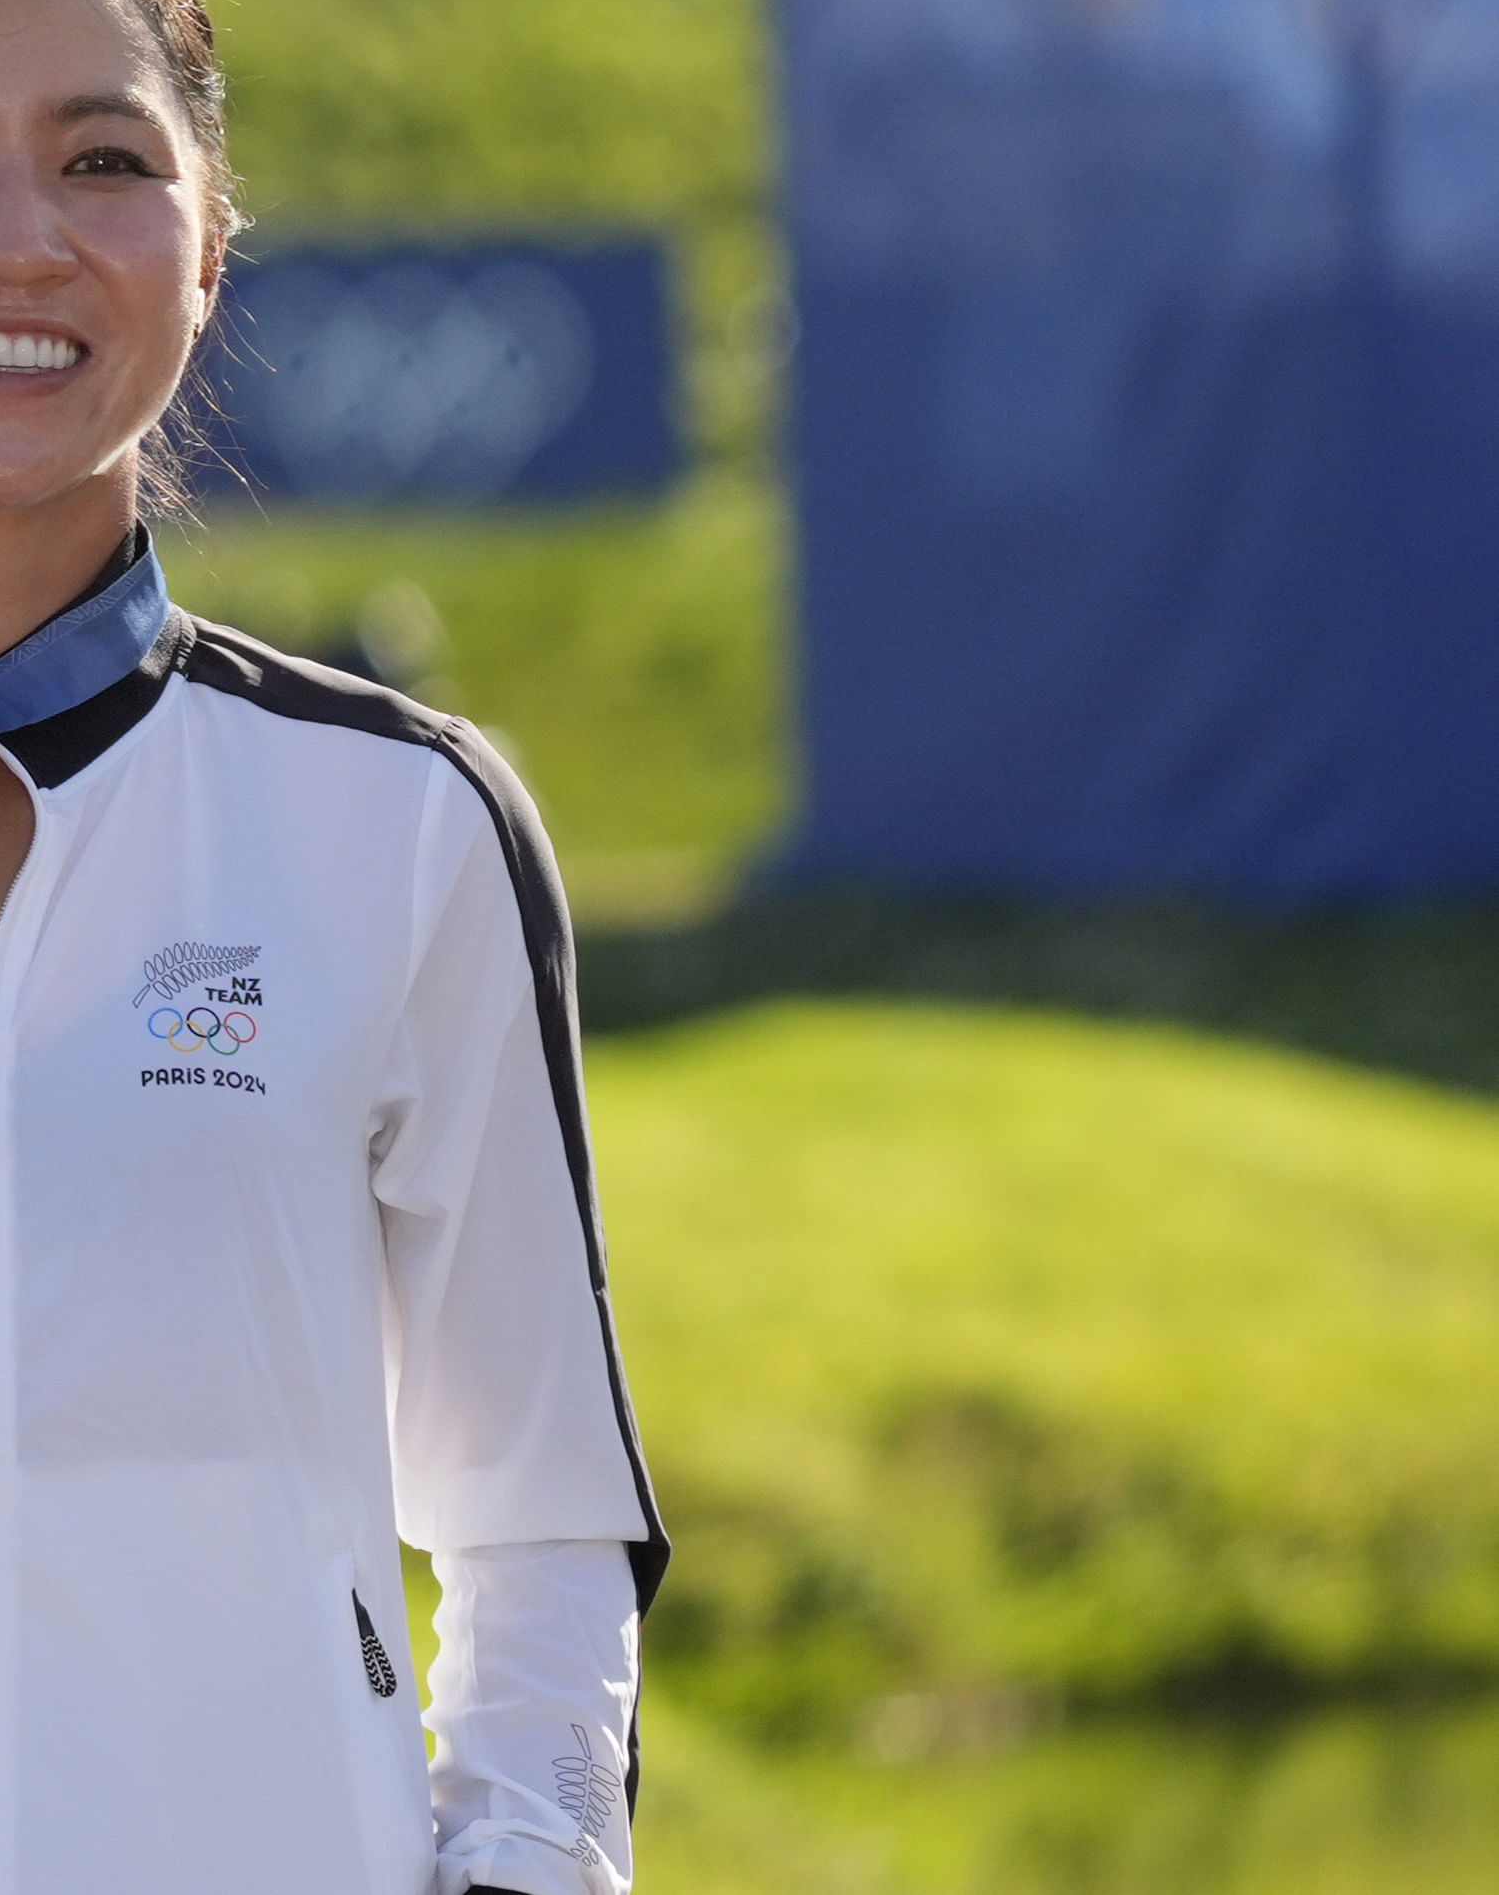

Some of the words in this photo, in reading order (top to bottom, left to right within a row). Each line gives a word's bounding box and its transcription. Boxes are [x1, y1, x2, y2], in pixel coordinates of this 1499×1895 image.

[232, 976, 261, 992] NZ
[205, 987, 263, 1006] TEAM
[213, 1069, 266, 1095] 2024
